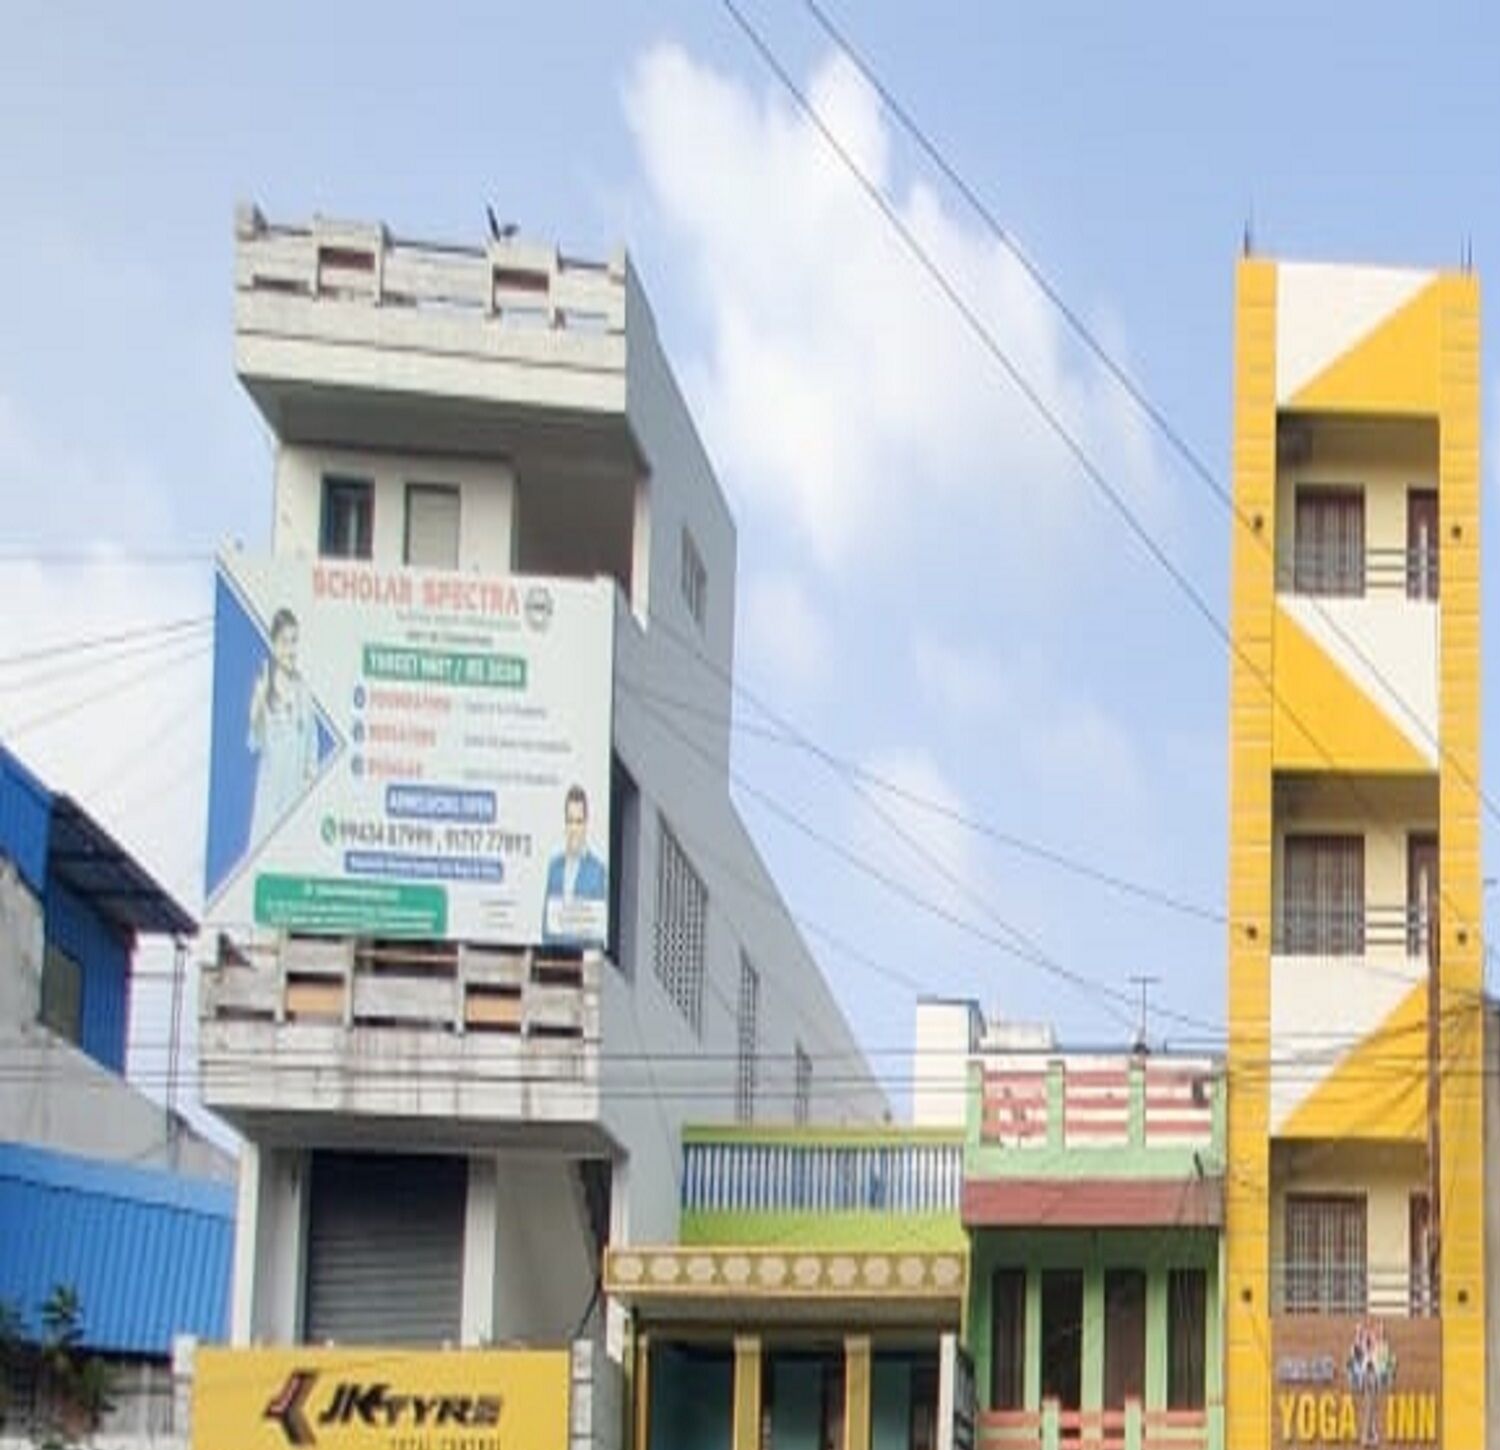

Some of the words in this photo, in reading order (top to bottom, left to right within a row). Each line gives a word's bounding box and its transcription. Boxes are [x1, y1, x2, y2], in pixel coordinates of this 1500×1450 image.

[313, 567, 413, 606] SCHOLAR
[422, 576, 520, 616] SPECTRA
[1280, 1392, 1357, 1440] YOGA
[1387, 1392, 1436, 1440] INN
